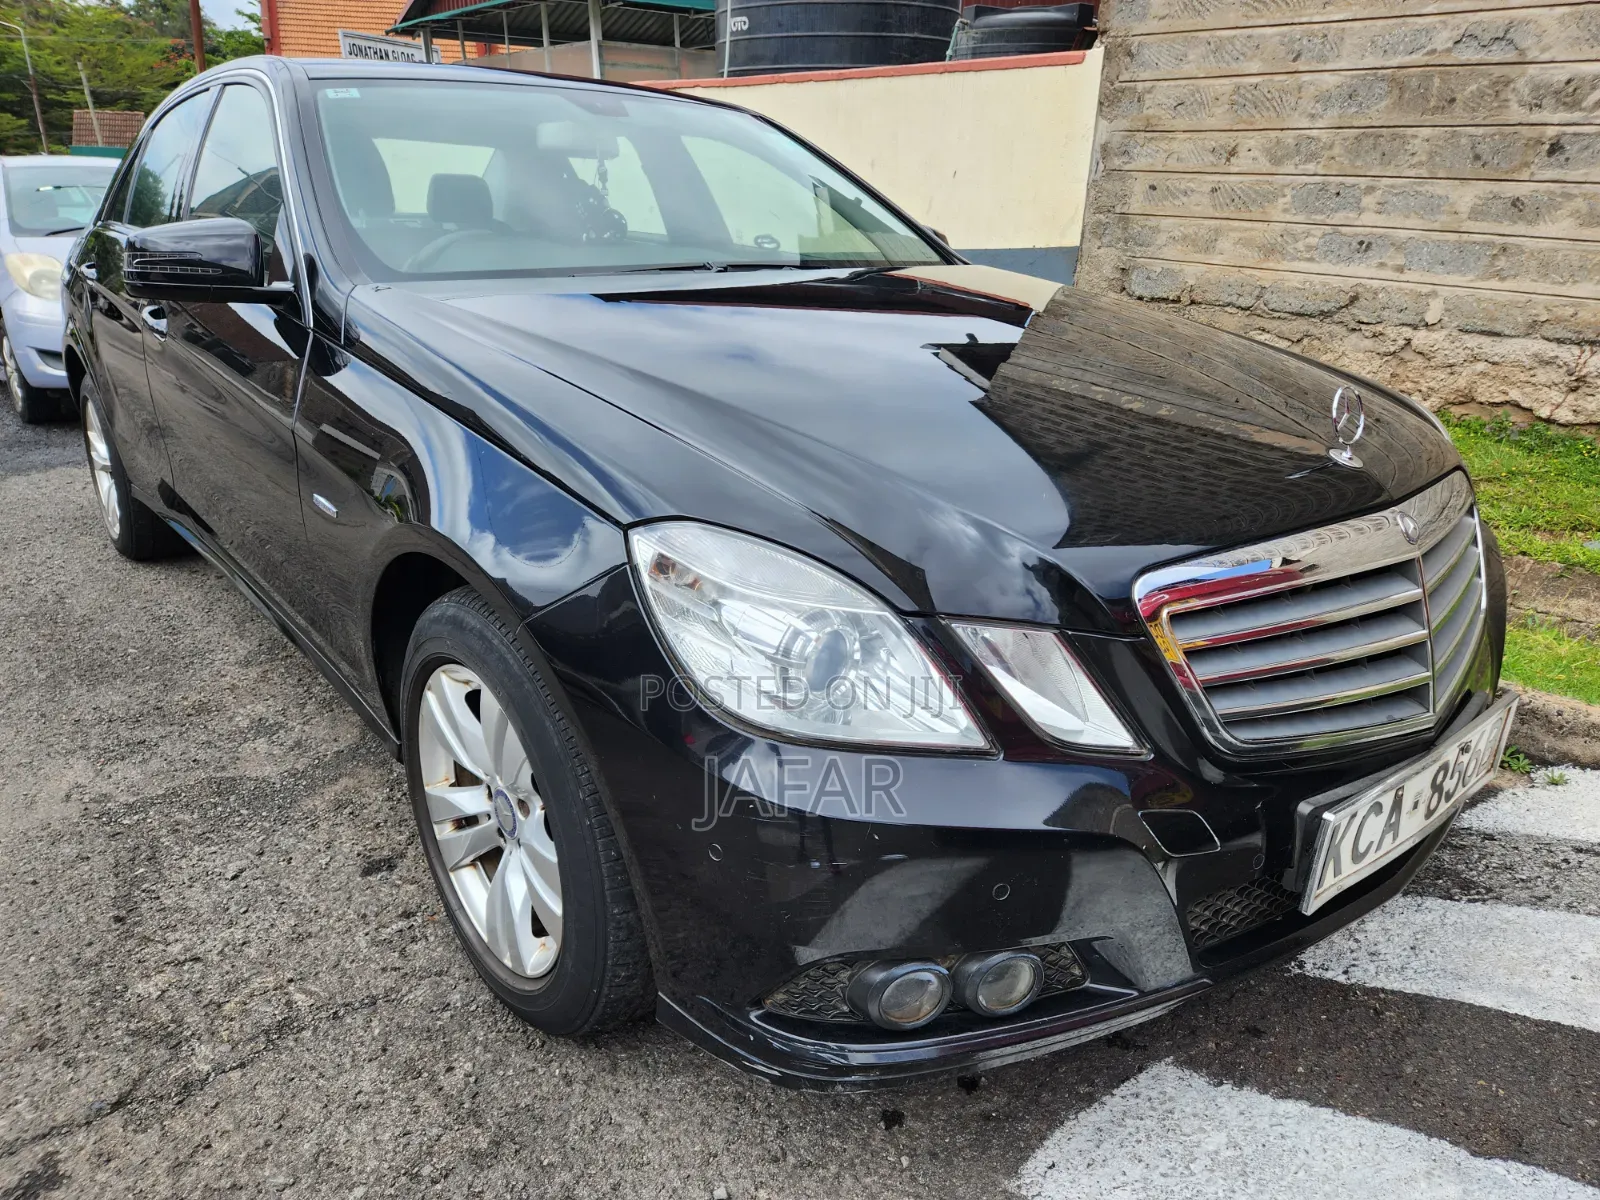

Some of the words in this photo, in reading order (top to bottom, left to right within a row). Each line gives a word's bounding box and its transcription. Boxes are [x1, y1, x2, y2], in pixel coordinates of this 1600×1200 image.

[729, 15, 749, 32] OTO
[347, 42, 390, 61] JONATHAN
[1317, 785, 1405, 891] KCA
